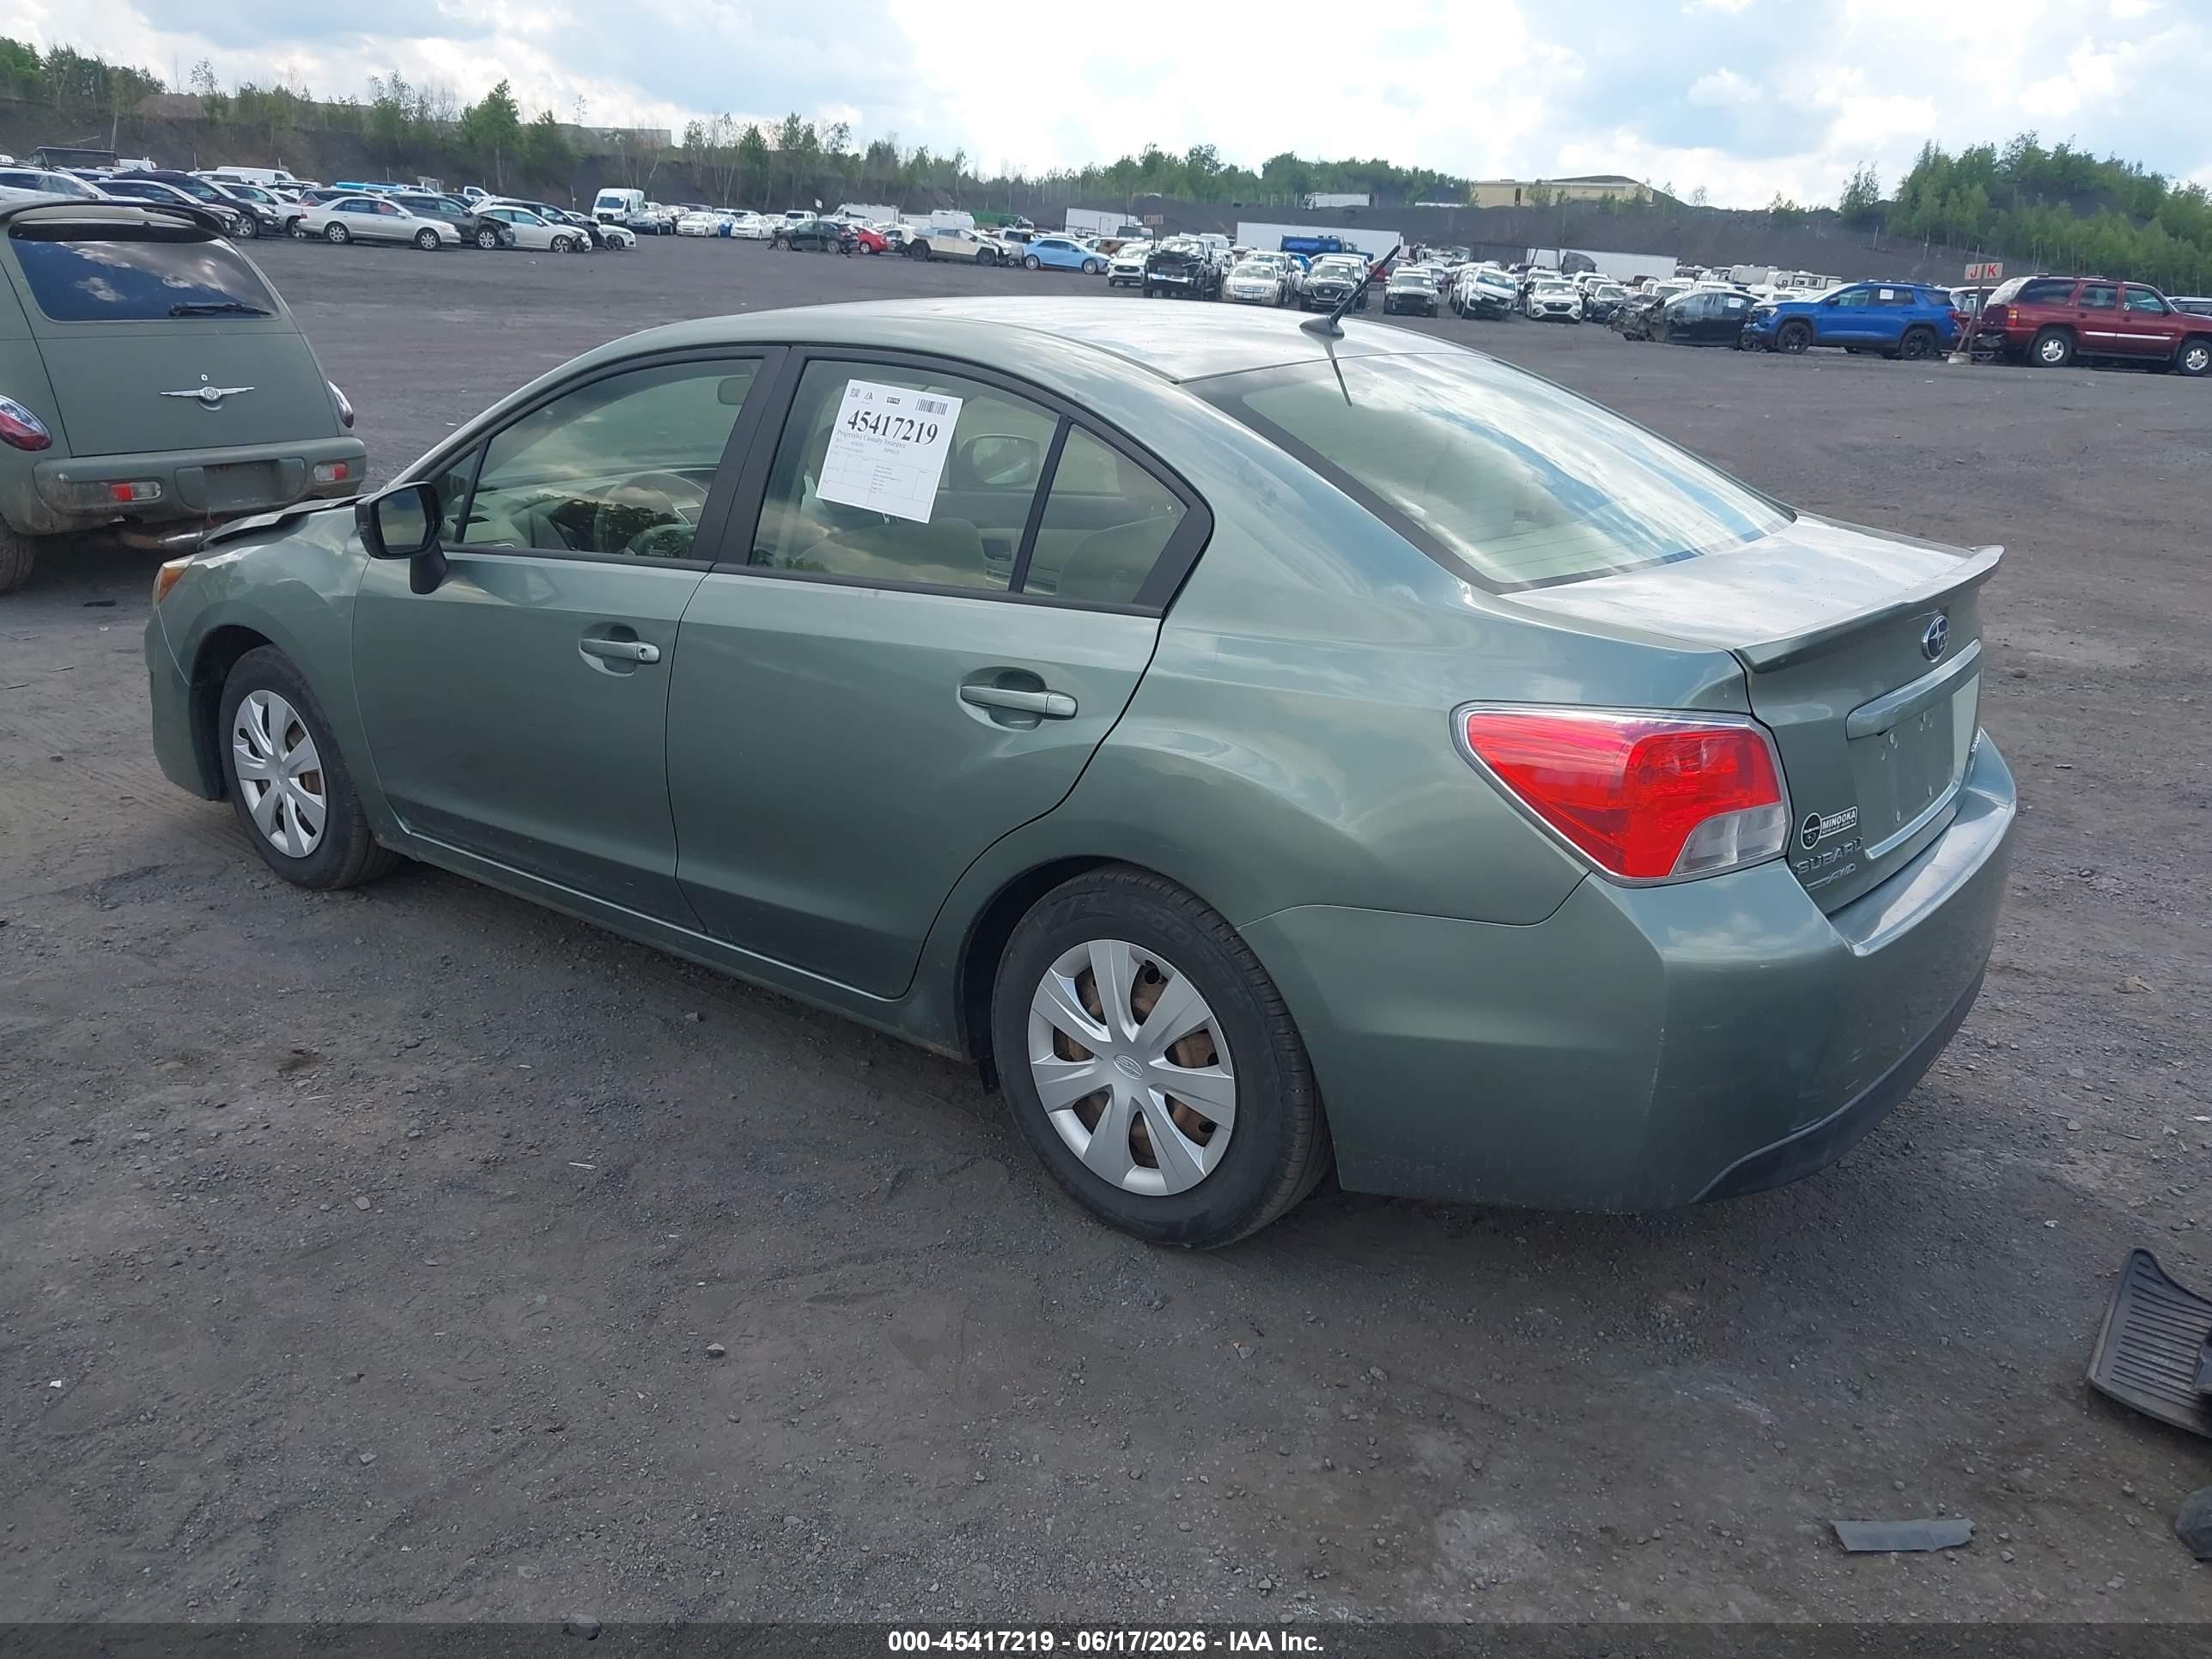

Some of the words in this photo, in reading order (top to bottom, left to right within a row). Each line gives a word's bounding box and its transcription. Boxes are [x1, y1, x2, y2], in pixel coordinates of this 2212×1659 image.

[1970, 265, 1979, 278] J
[1987, 264, 1998, 277] K
[847, 409, 939, 446] 45417219
[1821, 810, 1856, 831] MINOOKA
[1795, 836, 1863, 874] SUBARU
